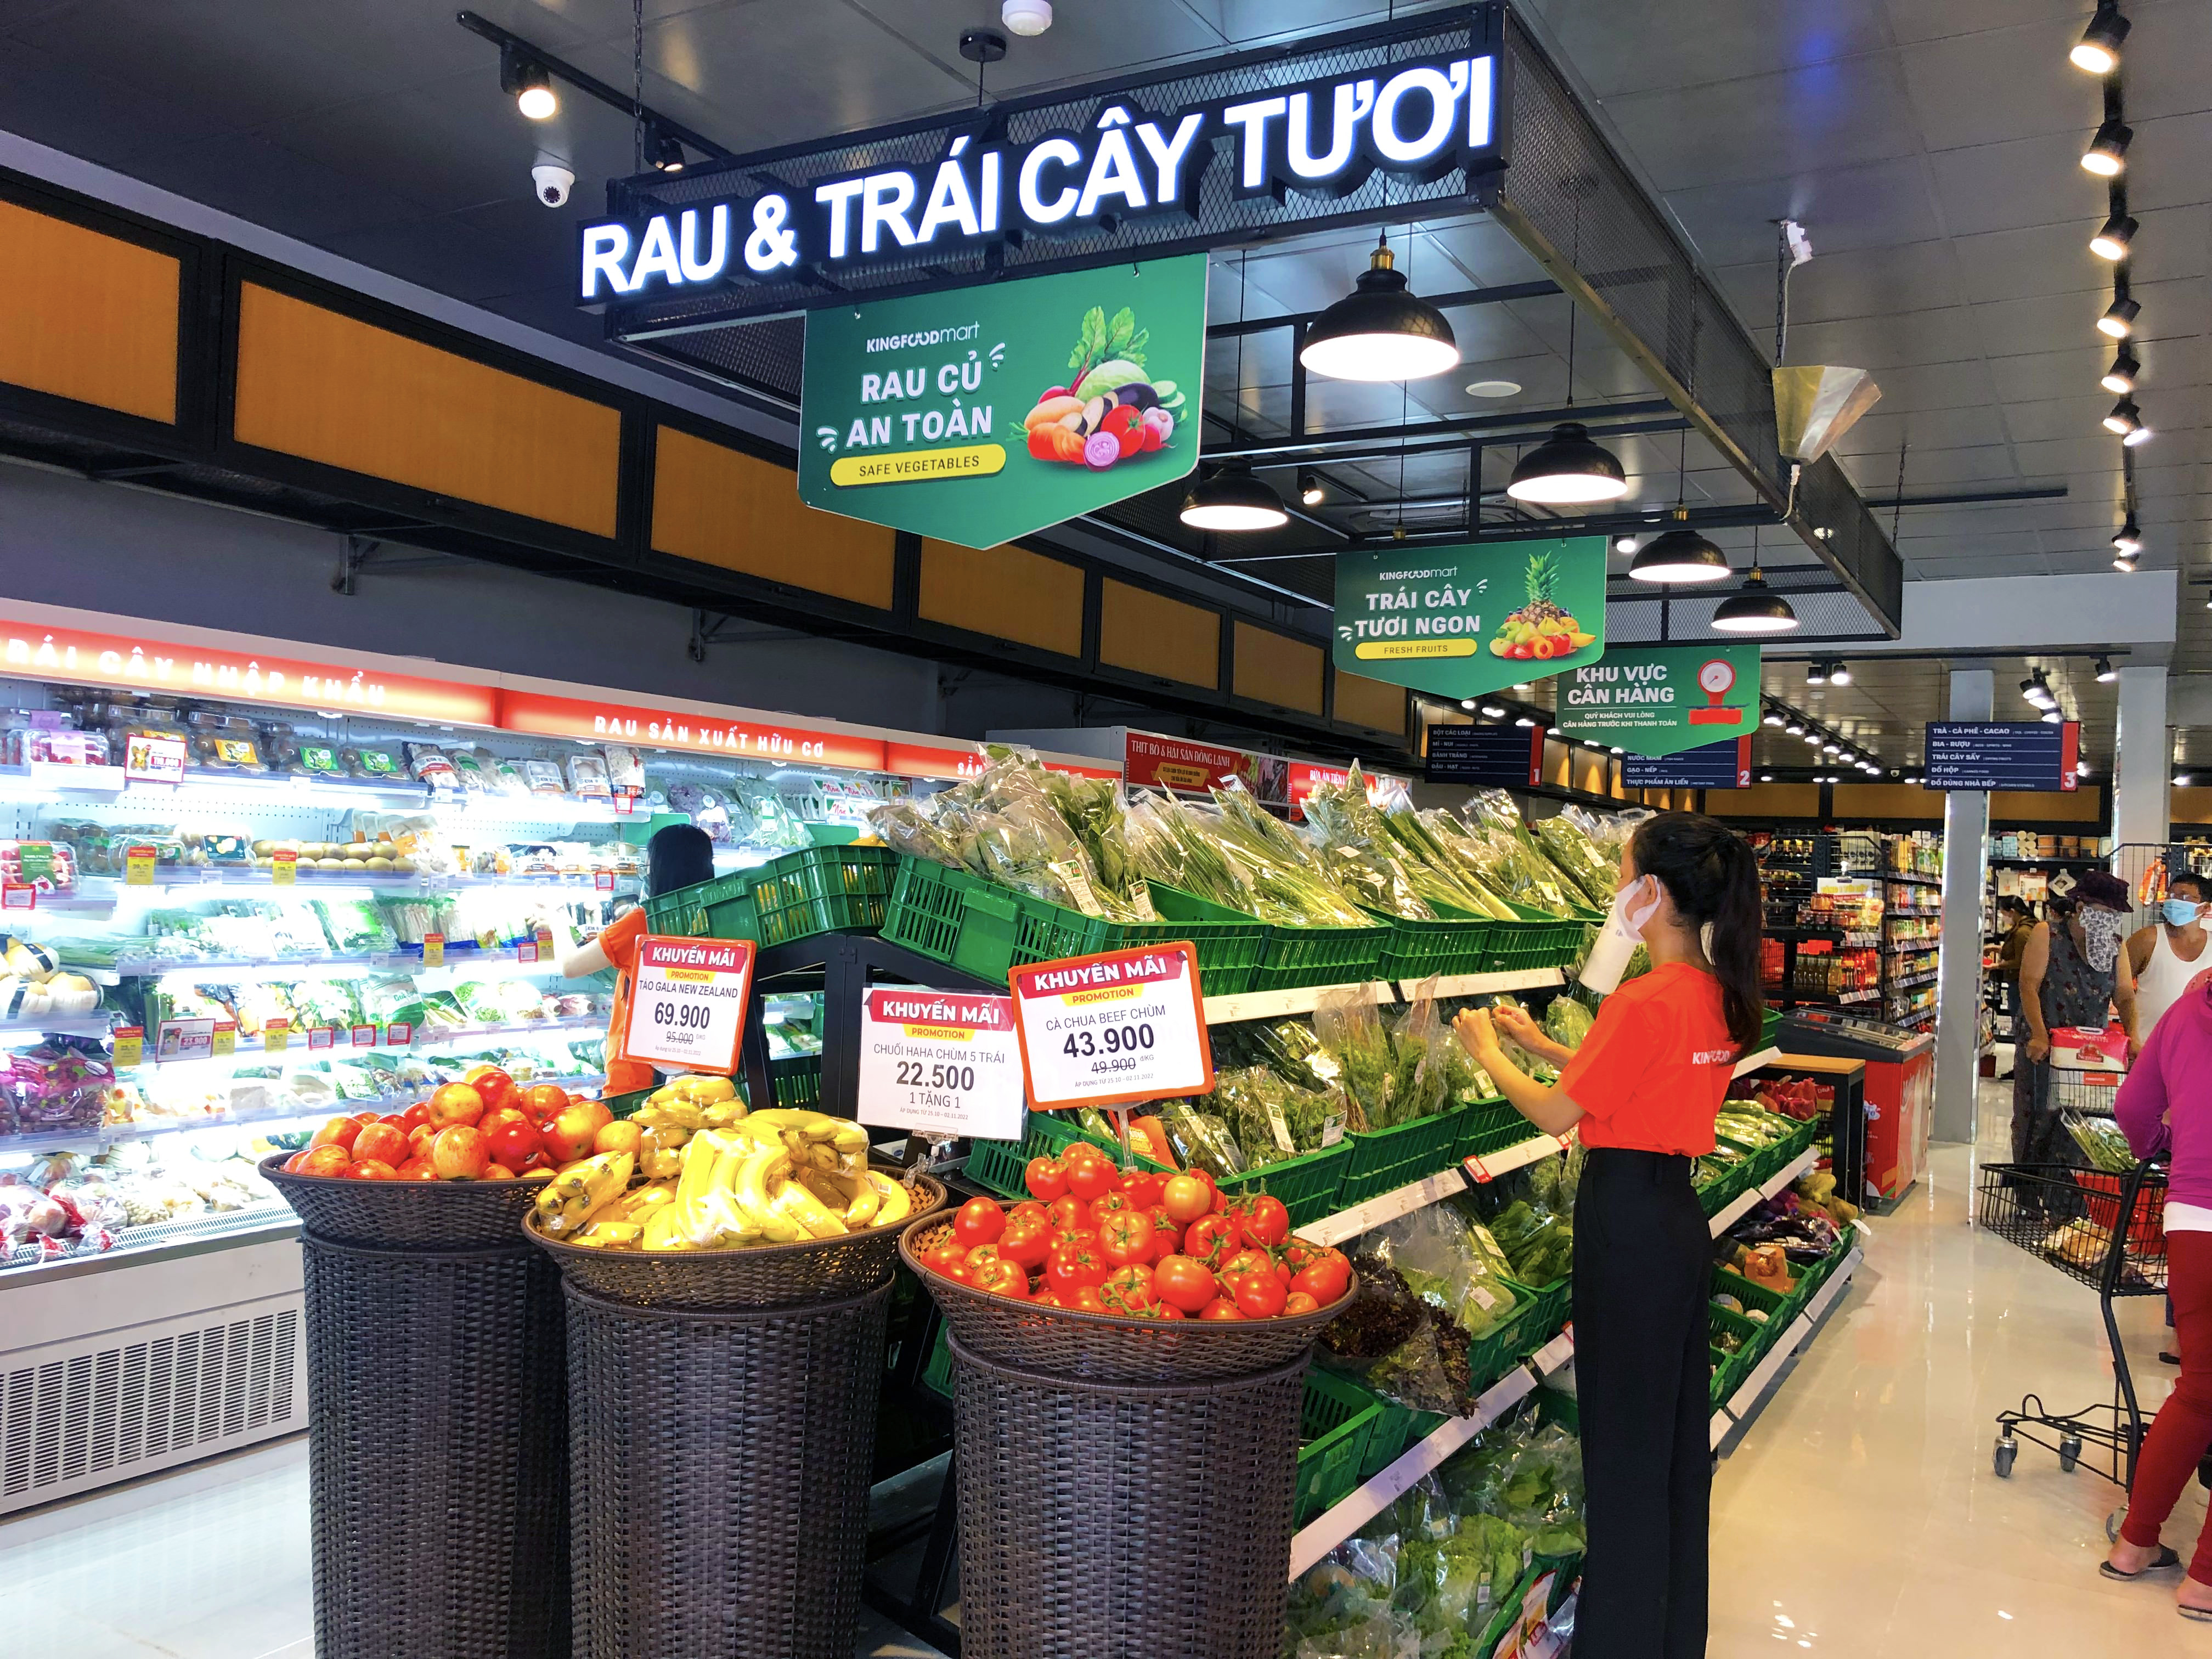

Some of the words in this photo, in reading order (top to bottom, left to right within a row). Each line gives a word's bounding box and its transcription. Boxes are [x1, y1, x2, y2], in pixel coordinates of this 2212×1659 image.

[582, 205, 727, 297] RAU
[743, 196, 798, 270] &
[816, 134, 999, 257] TRÁI
[1020, 115, 1203, 224] CÂY
[1226, 57, 1494, 187] TƯƠI
[866, 321, 979, 353] KINGFOODmart
[861, 366, 926, 403] RAU
[938, 351, 982, 394] CỦ
[847, 417, 890, 448] AN
[902, 398, 992, 442] TOÀN
[859, 462, 890, 477] SAFE
[895, 456, 979, 475] VEGETABLES
[1379, 566, 1458, 581] KINGFOODmart
[1365, 586, 1417, 611] TRÁI
[1425, 584, 1471, 607] CÂY
[1355, 617, 1407, 637] TƯƠI
[1415, 616, 1480, 635] NGON
[1384, 646, 1413, 654] FRESH
[1416, 645, 1448, 653] FRUITS
[194, 661, 284, 695] NHẬP
[1576, 667, 1618, 682] KHU
[1623, 663, 1667, 685] VỰC
[1568, 684, 1609, 704] CÂN
[1616, 682, 1674, 703] HÀNG
[594, 715, 636, 737] RAU
[648, 718, 689, 743] SẢN
[700, 724, 748, 750] XUẤT
[757, 732, 793, 754] HỮU
[802, 741, 824, 758] CƠ
[1131, 740, 1148, 757] THỊT
[1149, 742, 1159, 755] BÒ
[1167, 744, 1178, 759] HẢI
[1180, 746, 1193, 761] SẢN
[1194, 749, 1212, 764] ĐÔNG
[1213, 754, 1230, 768] LẠNH
[1534, 769, 1539, 782] 1
[1740, 770, 1750, 785] 2
[2064, 772, 2075, 788] 3
[652, 945, 706, 964] KHUYẾN
[708, 947, 735, 967] MÃI
[1125, 955, 1166, 977] MÃI
[671, 971, 709, 981] PROMOTION
[639, 978, 654, 990] TÁO
[656, 981, 676, 993] GALA
[679, 984, 698, 995] NEW
[698, 985, 738, 998] ZEALAND
[1073, 988, 1134, 1003] PROMOTION
[654, 1002, 710, 1029] 69.900
[883, 999, 956, 1021] KHUYẾN
[962, 1003, 999, 1024] MÃI
[1046, 1017, 1061, 1031] CÀ
[1064, 1014, 1096, 1029] CHUA
[1099, 1010, 1126, 1024] BEEF
[1130, 1004, 1166, 1019] CHÙM
[912, 1027, 964, 1039] PROMOTION
[1063, 1023, 1154, 1058] 43.900
[874, 1042, 904, 1056] CHUỐI
[907, 1046, 933, 1058] HAHA
[936, 1047, 967, 1061] CHÙM
[970, 1052, 975, 1061] 5
[979, 1051, 1005, 1063] TRÁI
[896, 1061, 974, 1091] 22.500
[1091, 1057, 1136, 1074] 49.900
[910, 1092, 915, 1103] 1
[919, 1090, 950, 1107] TẶNG
[955, 1097, 960, 1108] 1
